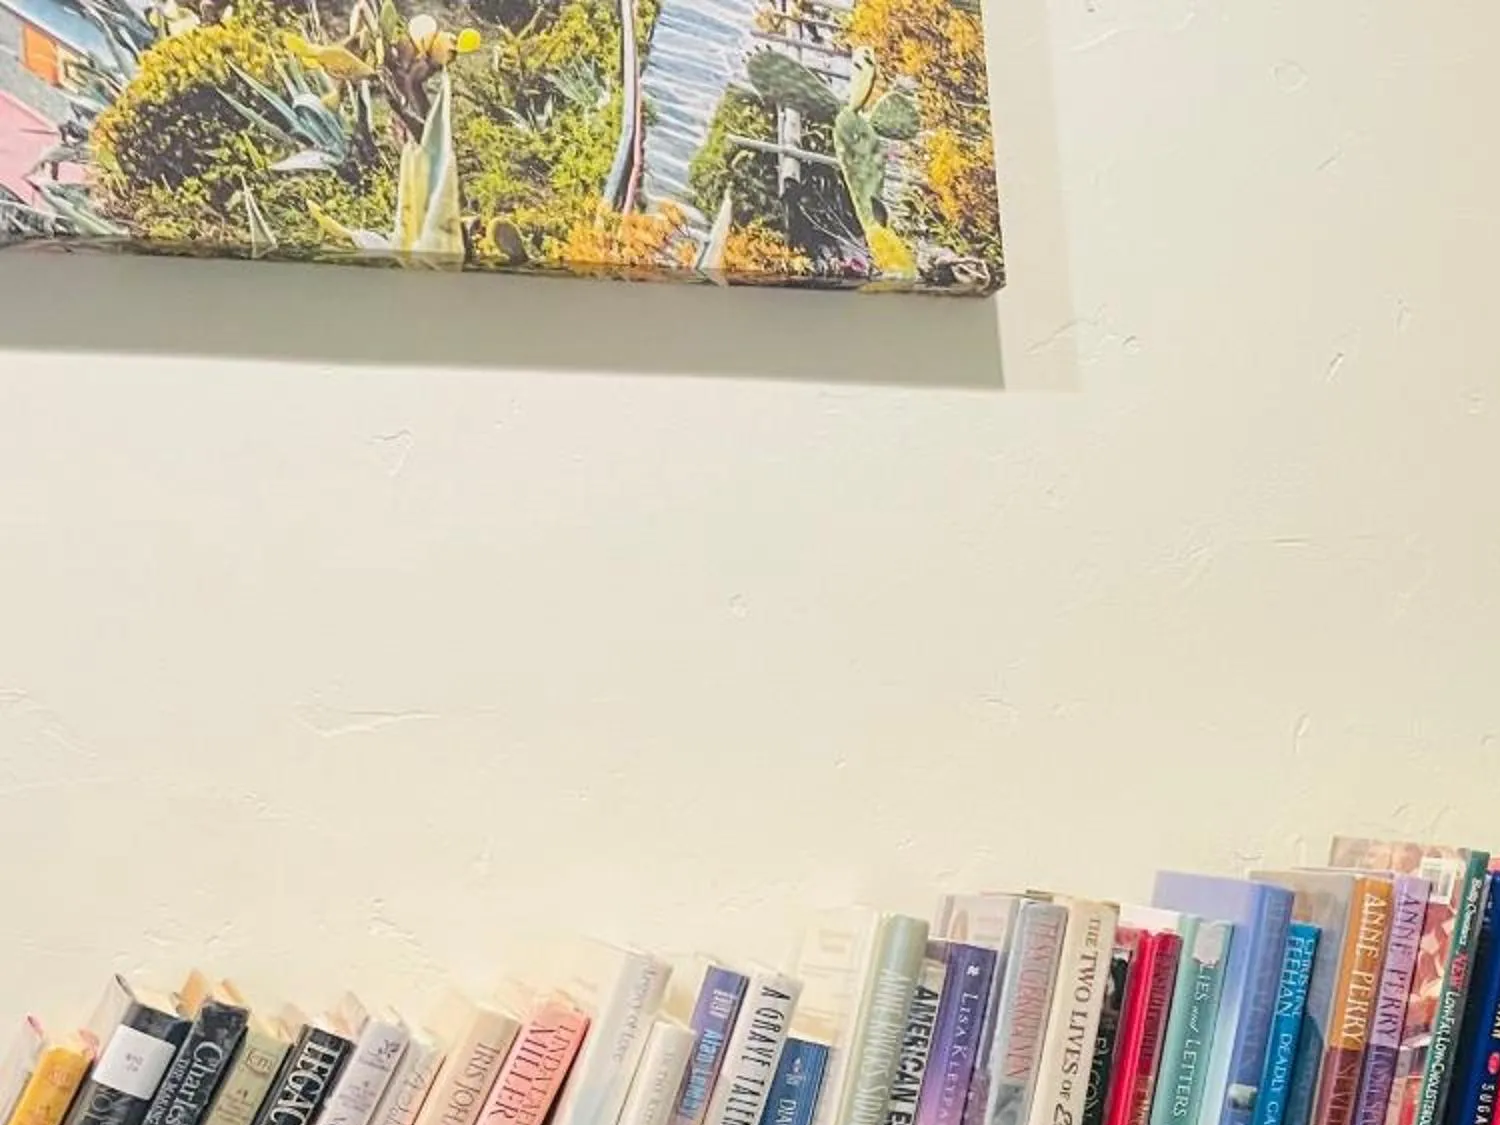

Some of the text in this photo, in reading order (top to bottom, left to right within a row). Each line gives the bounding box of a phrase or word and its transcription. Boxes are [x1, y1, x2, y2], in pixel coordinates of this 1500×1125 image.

[1082, 917, 1102, 948] THE
[1353, 893, 1386, 958] ANNE
[760, 985, 787, 1003] A
[873, 969, 908, 1017] ANNE
[1072, 949, 1097, 1003] TWO
[1192, 962, 1214, 1002] LIES
[1373, 892, 1423, 1042] ANNE PERRY
[1448, 949, 1468, 990] NEW
[741, 1004, 785, 1067] GRAVE
[953, 991, 979, 1038] LISA
[1338, 968, 1374, 1044] PERRY
[462, 1041, 500, 1082] IRIS
[860, 1018, 900, 1079] RIVERS
[889, 985, 940, 1104] AMERICAN
[1060, 1009, 1087, 1074] LIVES
[1269, 1032, 1292, 1092] DEADLY
[488, 1019, 556, 1125] MILLER
[1057, 1078, 1072, 1100] OF
[1170, 1038, 1200, 1117] LETTERS
